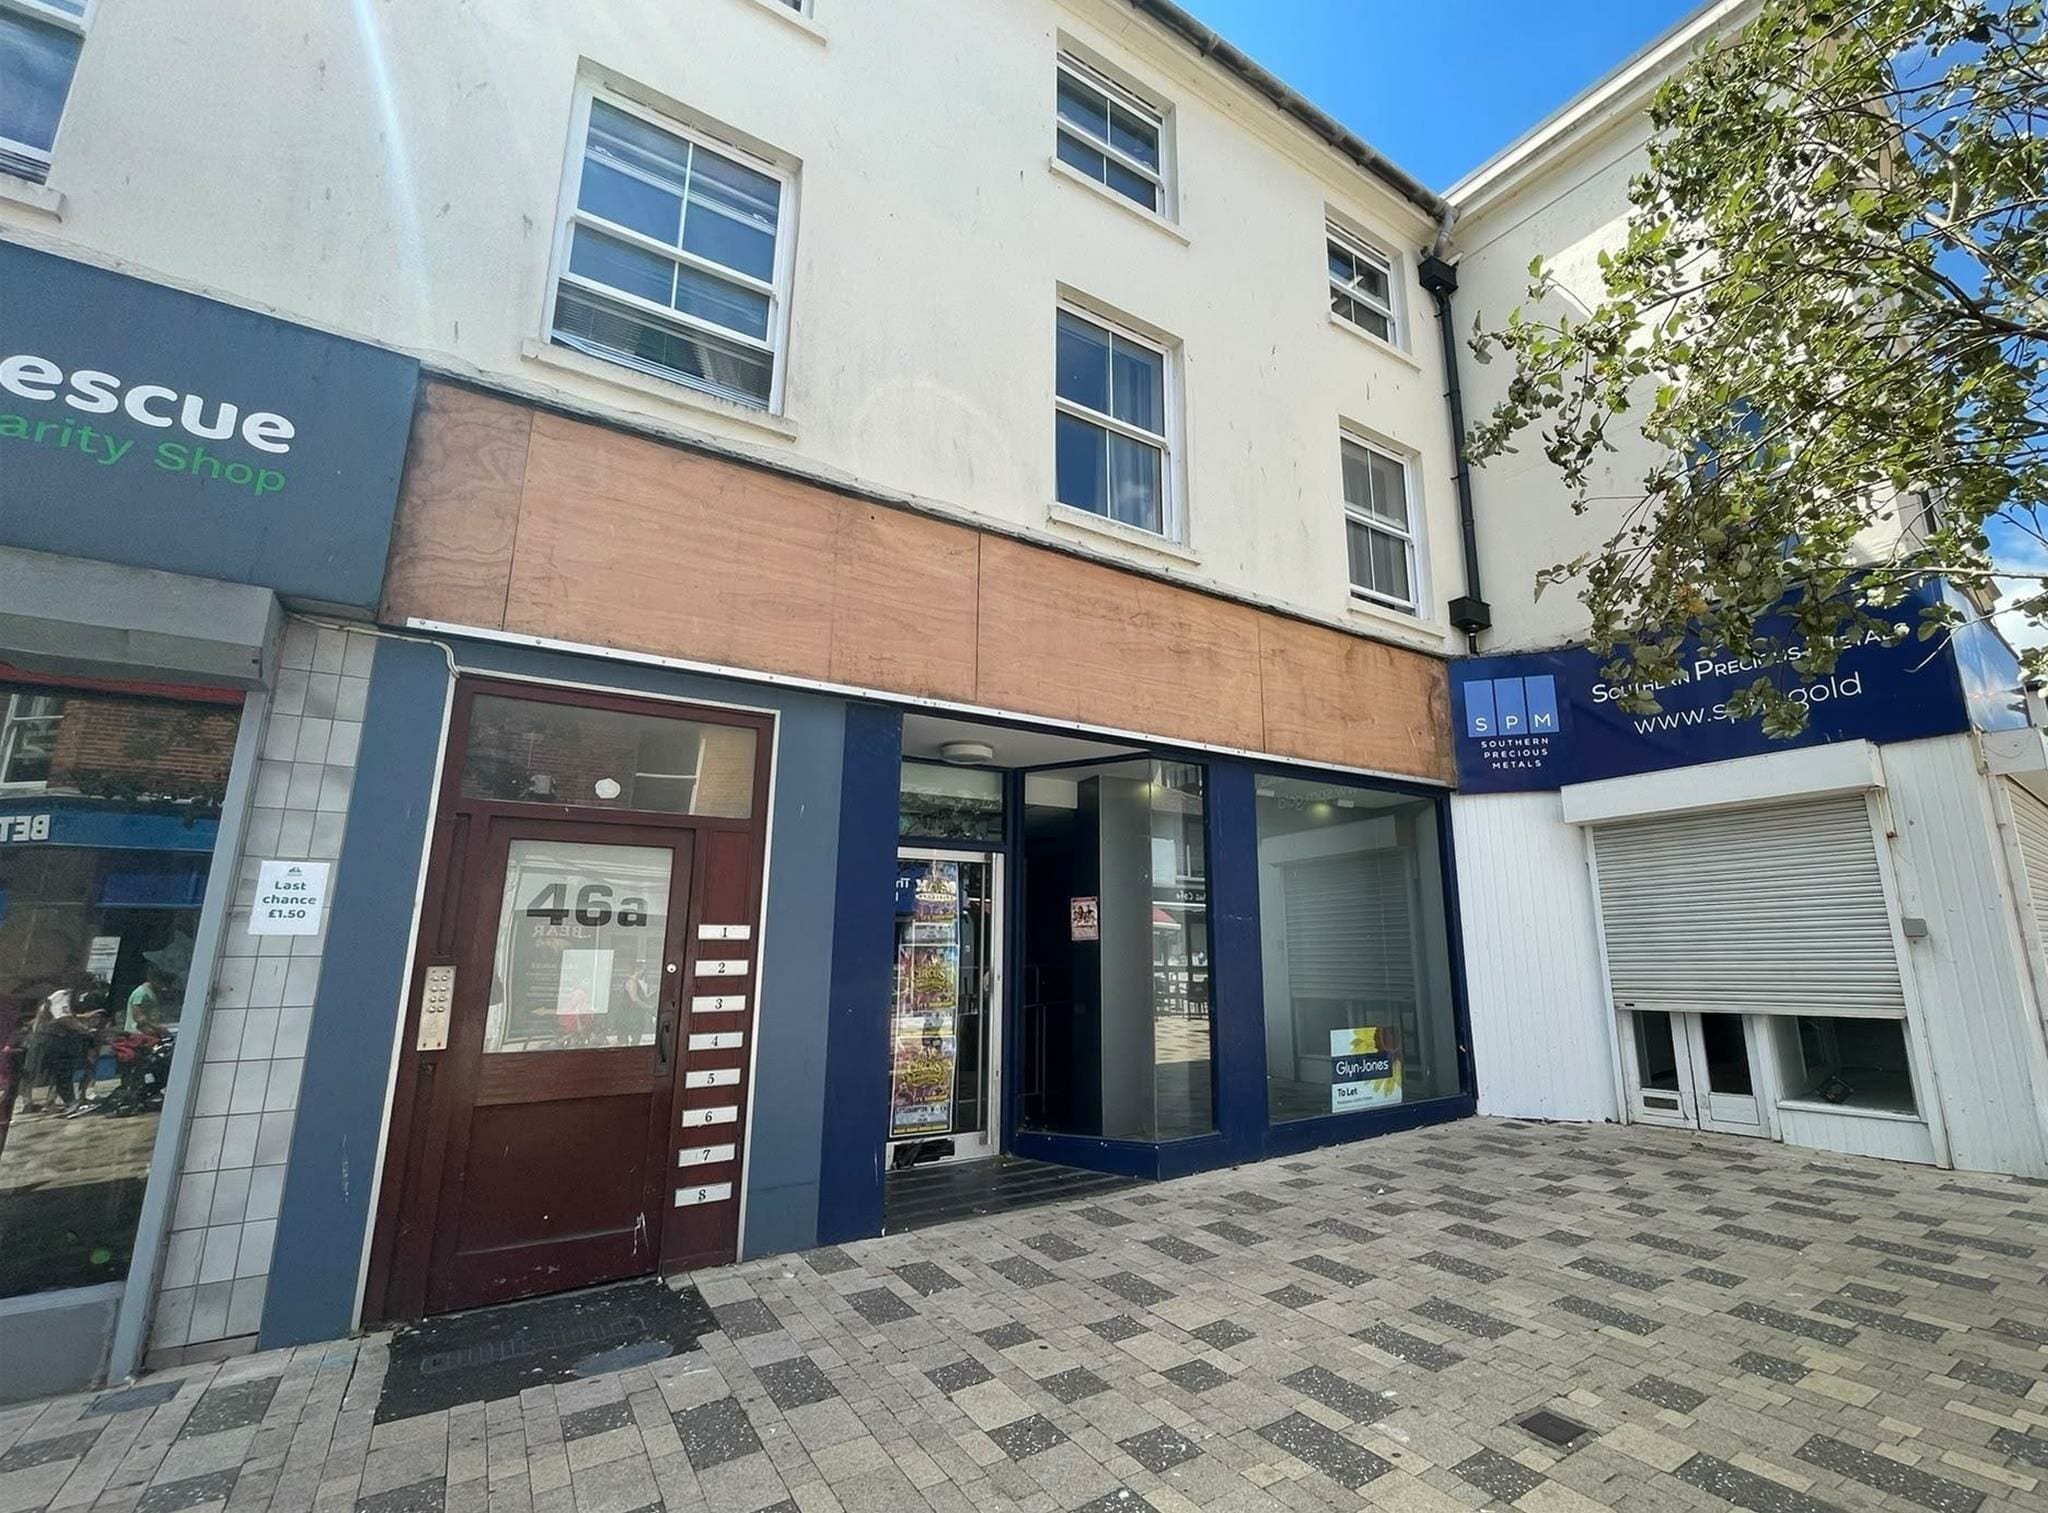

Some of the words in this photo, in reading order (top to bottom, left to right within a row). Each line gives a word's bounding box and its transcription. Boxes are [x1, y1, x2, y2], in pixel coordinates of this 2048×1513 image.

[0, 354, 295, 454] escue
[154, 441, 286, 496] Shop
[1694, 646, 1801, 681] PRECIS
[1480, 737, 1549, 749] SOUTHERN
[1483, 748, 1549, 759] PRECIOUS
[1492, 759, 1542, 769] METALS
[274, 881, 307, 891] Last
[262, 894, 317, 905] chance
[526, 883, 648, 927] 46a
[268, 909, 306, 919] £1.50
[722, 927, 727, 938] 1
[718, 962, 727, 974] 2
[714, 998, 723, 1010] 3
[711, 1035, 719, 1047] 4
[1336, 1060, 1389, 1078] Glyn-Jones
[707, 1073, 716, 1085] 5
[1337, 1088, 1346, 1097] To
[1346, 1088, 1358, 1097] Let
[704, 1110, 713, 1123] 6
[702, 1148, 711, 1161] 7
[697, 1188, 707, 1202] 8
